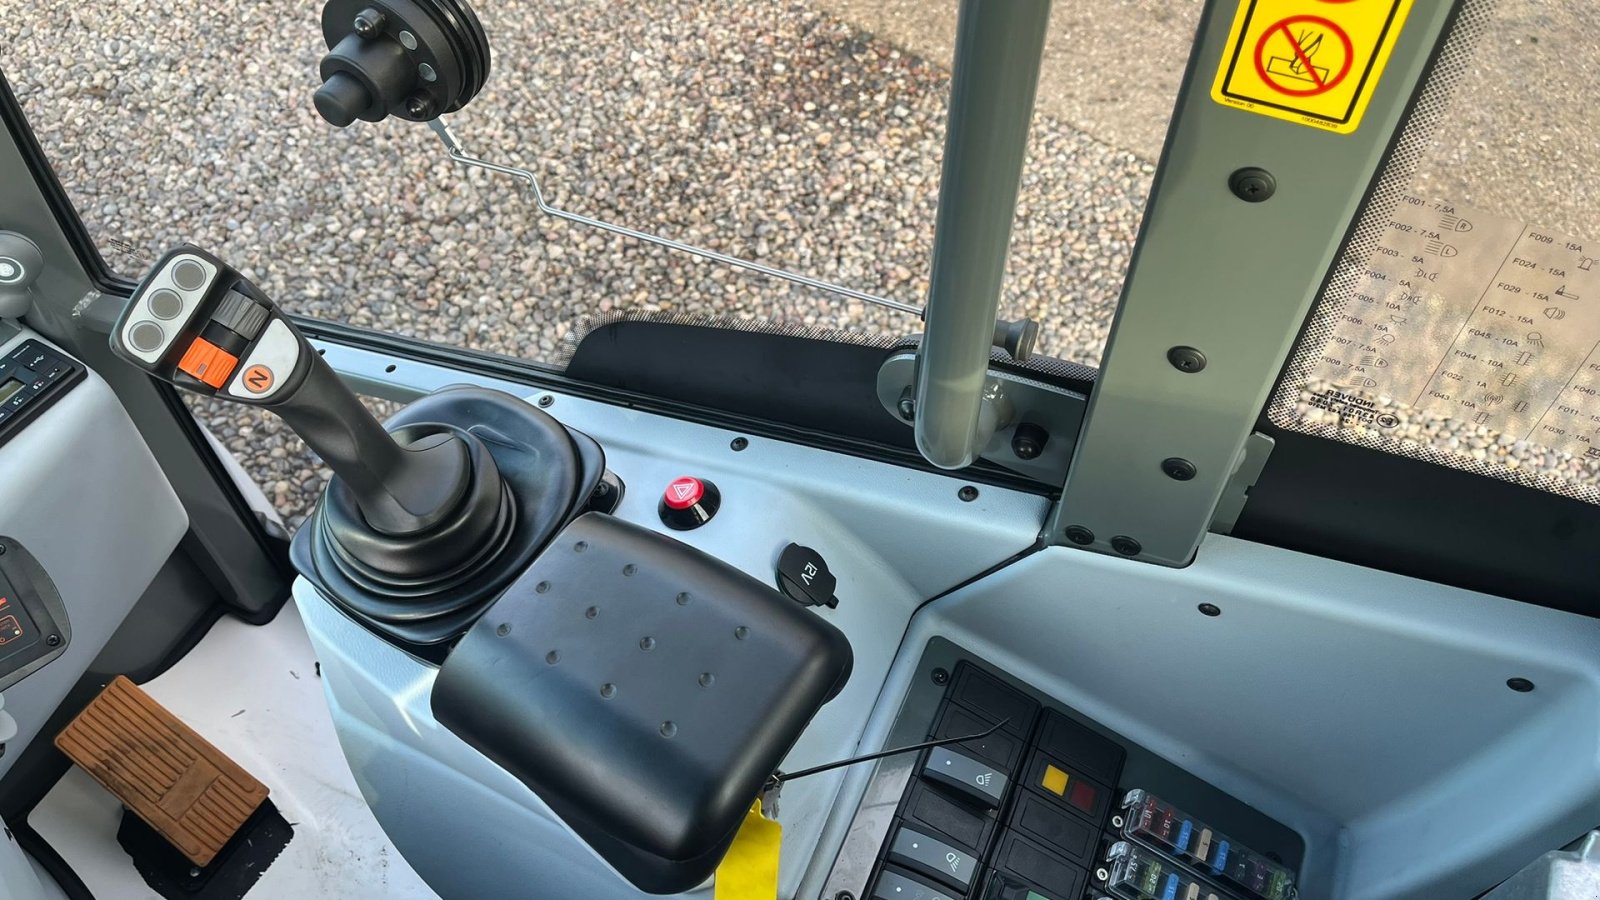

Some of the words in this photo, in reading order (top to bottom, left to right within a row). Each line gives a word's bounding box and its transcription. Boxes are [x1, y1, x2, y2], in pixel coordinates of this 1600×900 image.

[1402, 195, 1426, 207] F001
[1389, 221, 1412, 232] F002
[1528, 232, 1553, 244] F009
[1565, 242, 1582, 252] 15A
[1376, 246, 1399, 257] F003
[1411, 256, 1424, 264] 5A
[1512, 257, 1537, 269] F024
[1548, 267, 1566, 278] 15A
[1364, 270, 1386, 281] F004
[1399, 280, 1411, 288] 5A
[1497, 282, 1521, 294] F029
[1532, 292, 1549, 302] 15A
[1353, 293, 1375, 304] F005
[1386, 302, 1401, 311] 10A
[1342, 315, 1363, 325] F006
[1374, 323, 1388, 332] 15A
[1482, 305, 1506, 317] F012
[1517, 315, 1534, 325] 15A
[1331, 336, 1352, 345] F007
[1468, 328, 1492, 340] F045
[1502, 338, 1518, 347] 10A
[1321, 356, 1341, 366] F008
[1454, 349, 1477, 361] F044
[1487, 359, 1504, 368] 10A
[249, 369, 268, 388] N
[1441, 370, 1464, 382] F022
[1476, 381, 1487, 389] 1A
[1428, 390, 1451, 401] F043
[1461, 400, 1476, 409] 10A
[1573, 385, 1596, 396] F040
[1590, 415, 1600, 423] 15
[1543, 425, 1565, 435] F030
[1575, 434, 1590, 444] 15A
[801, 561, 818, 586] 12V
